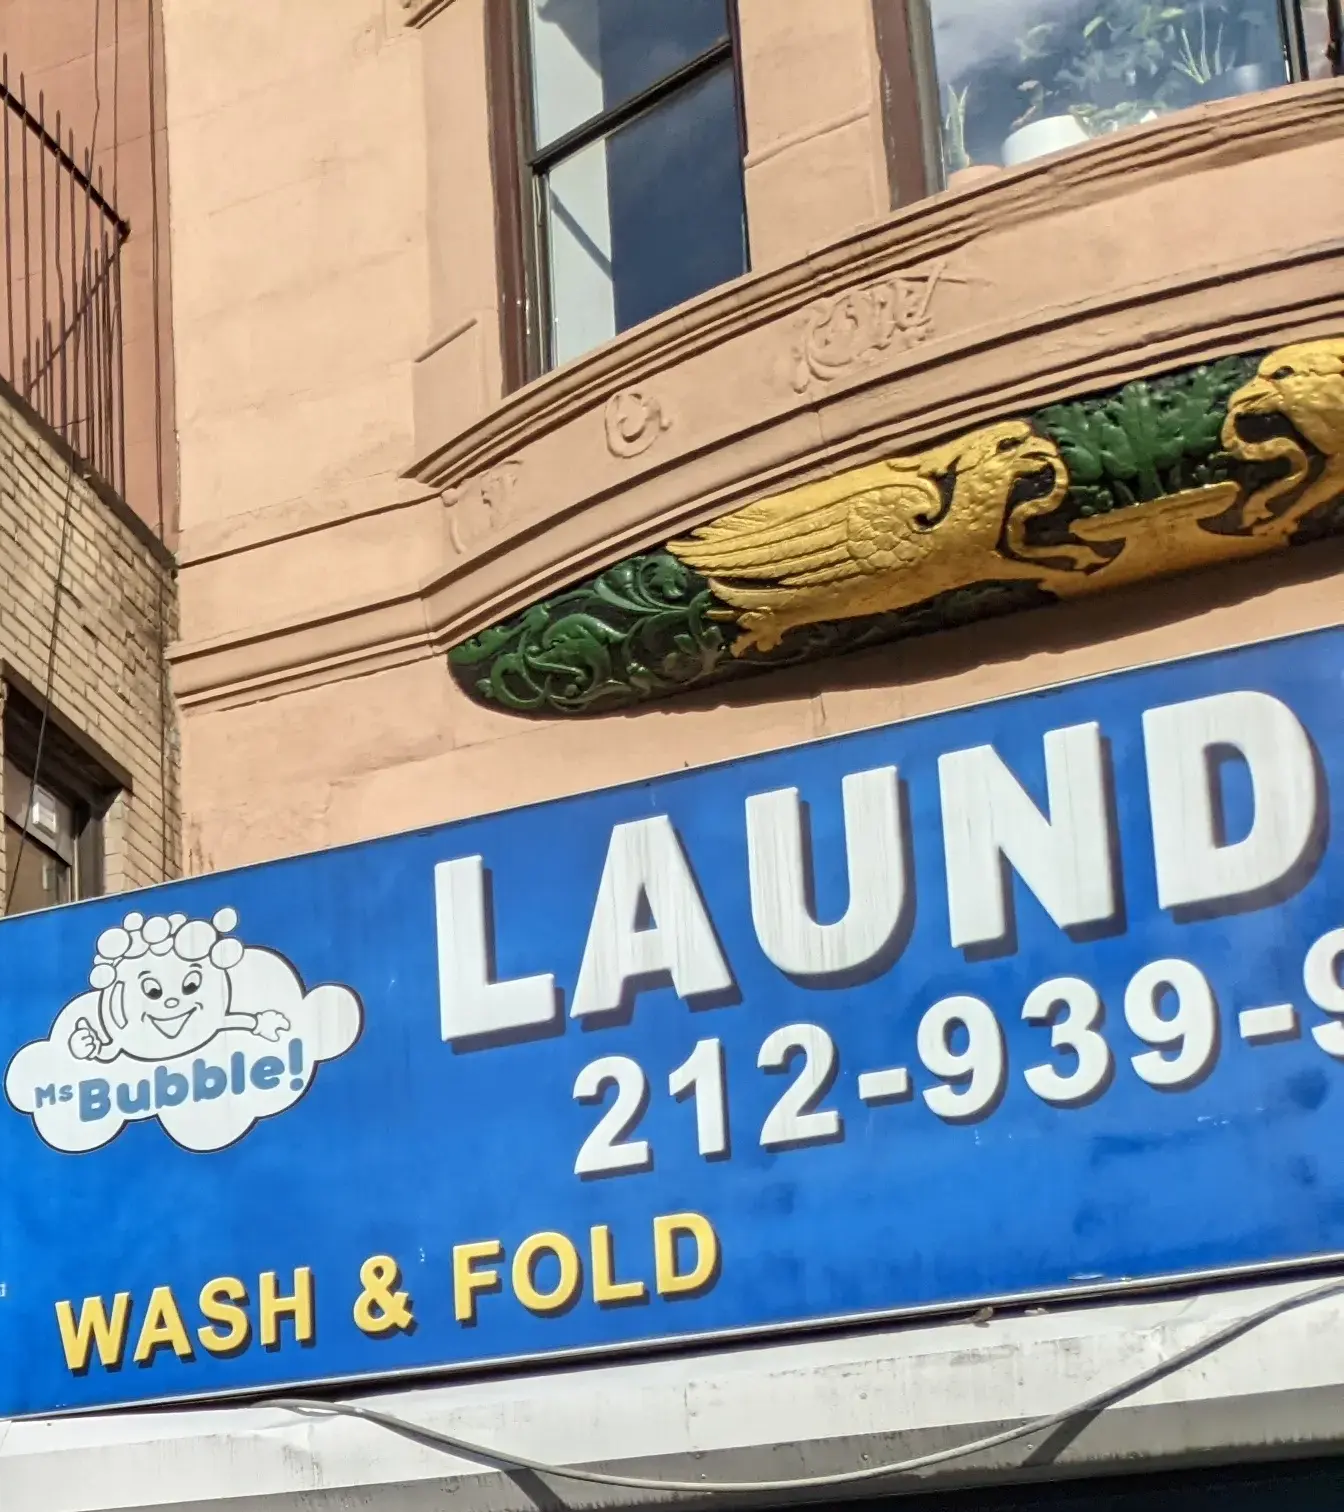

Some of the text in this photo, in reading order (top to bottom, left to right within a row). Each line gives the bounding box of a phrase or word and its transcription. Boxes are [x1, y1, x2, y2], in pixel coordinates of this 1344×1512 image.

[76, 1037, 307, 1121] Bubble!
[55, 1212, 720, 1373] WASH & FOLD
